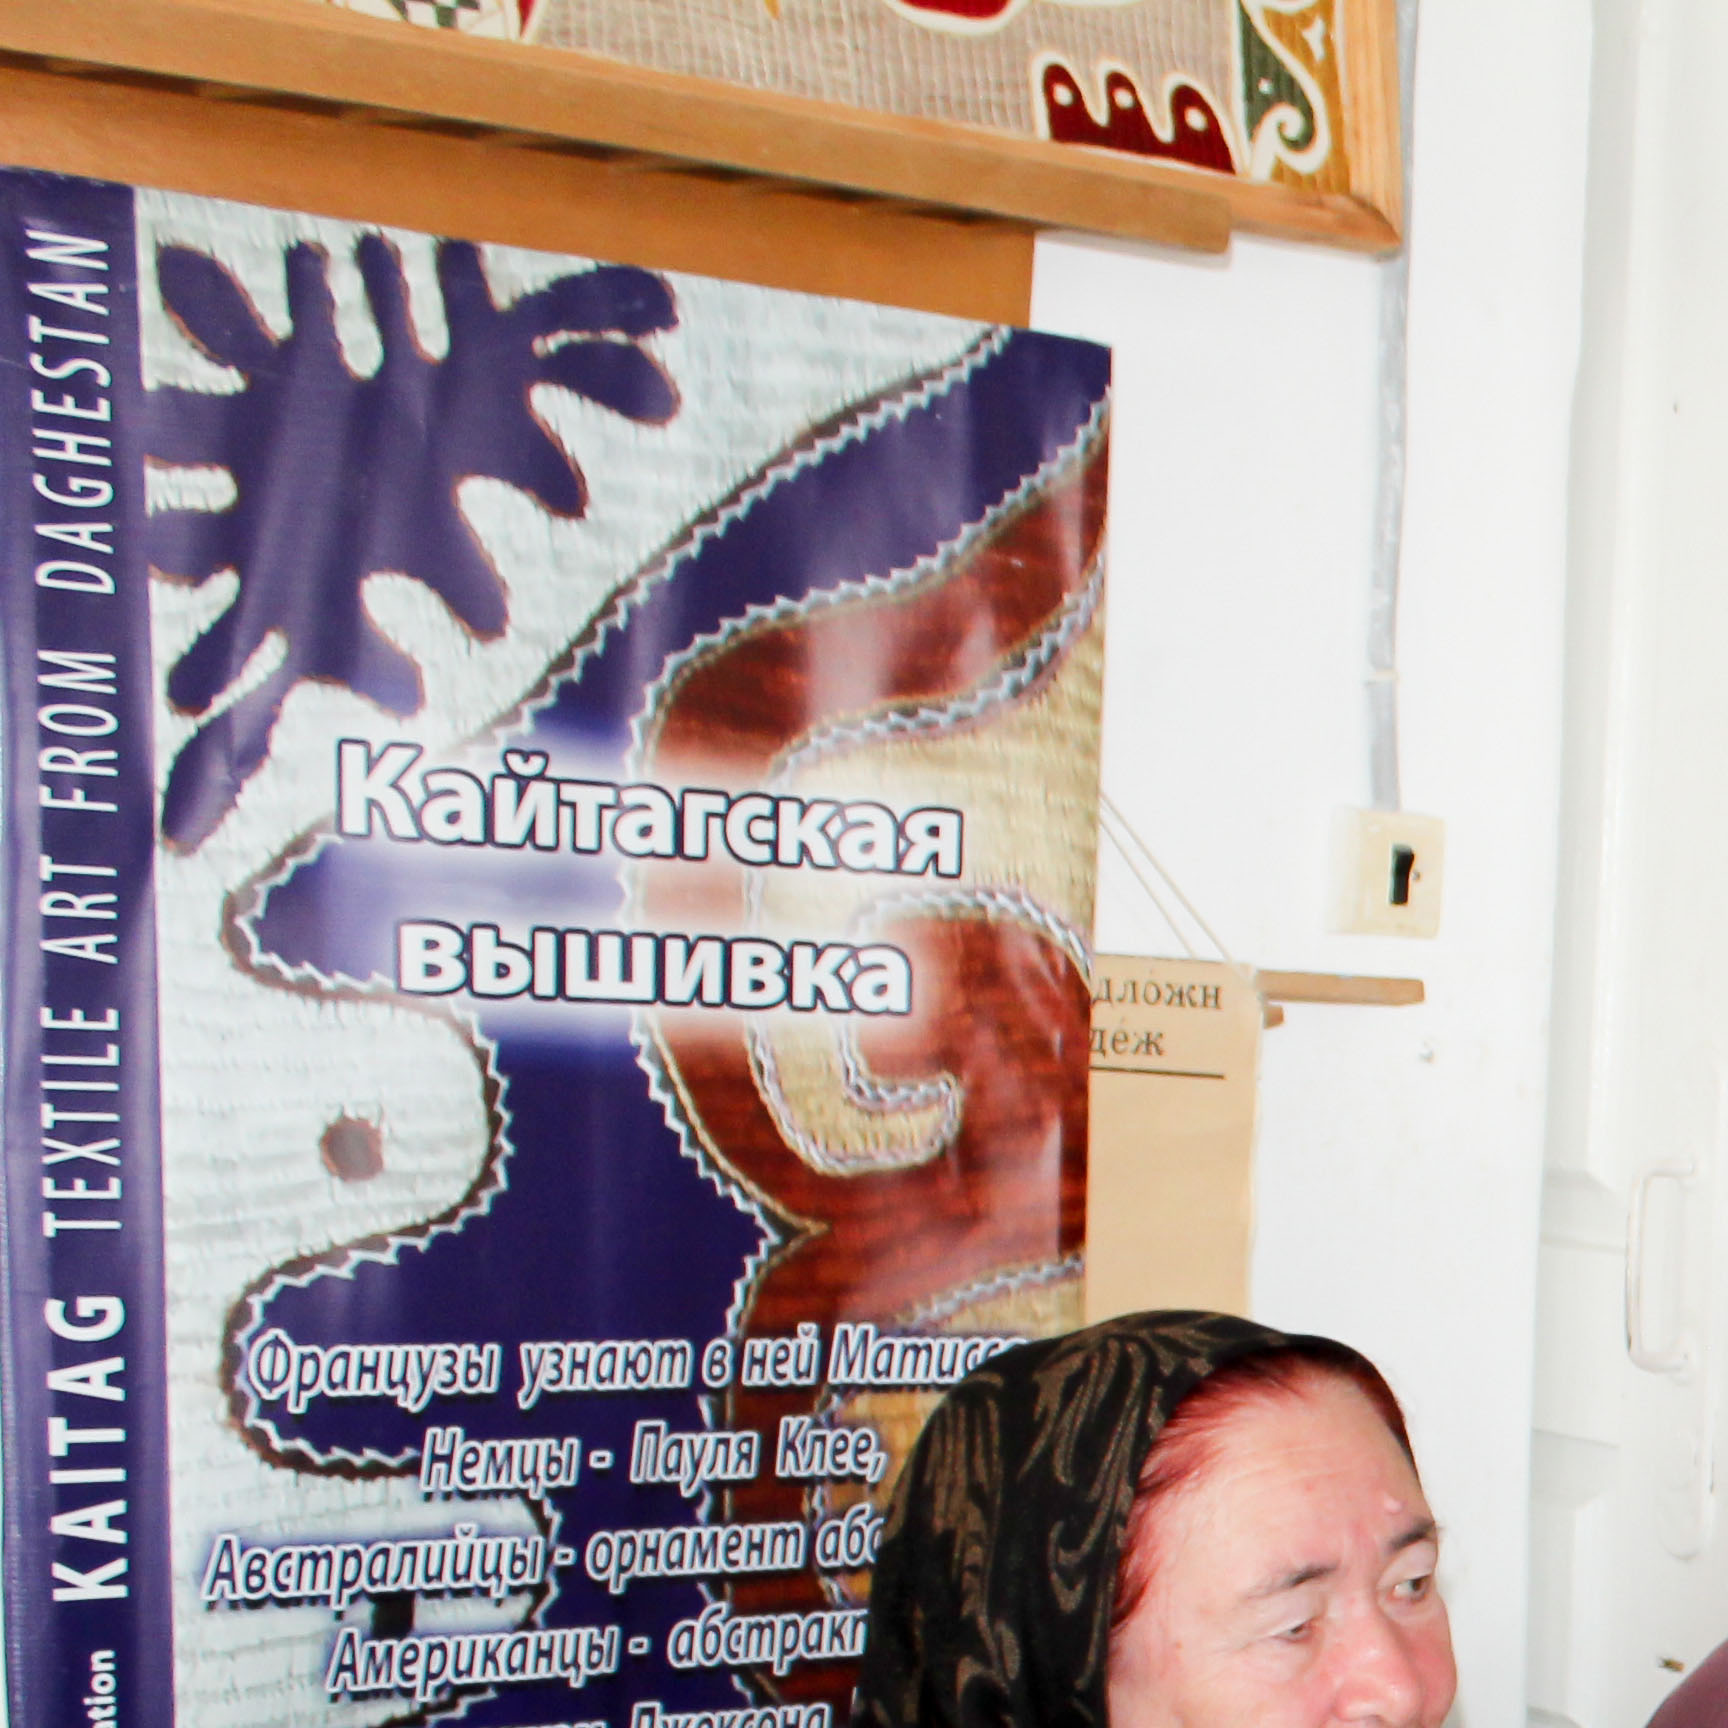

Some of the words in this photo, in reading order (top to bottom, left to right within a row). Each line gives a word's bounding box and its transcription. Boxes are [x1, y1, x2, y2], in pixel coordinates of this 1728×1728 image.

[25, 227, 117, 595] DAGHESTAN
[37, 648, 120, 813] FROM
[337, 738, 965, 879] Кайтагская
[39, 855, 119, 965] ART
[398, 919, 914, 1014] вышивка
[40, 1006, 123, 1238] TEXTILE
[247, 1328, 503, 1414] Французы
[517, 1339, 694, 1409] узнают
[701, 1338, 734, 1388] в
[741, 1323, 821, 1387] ней
[45, 1293, 129, 1603] KAITAG
[419, 1426, 582, 1499] Немцы
[629, 1419, 762, 1499] Пауля
[775, 1415, 889, 1484] Клее,
[203, 1522, 548, 1612] Австралийцы
[584, 1521, 808, 1595] орнамент
[326, 1624, 621, 1700] Американцы
